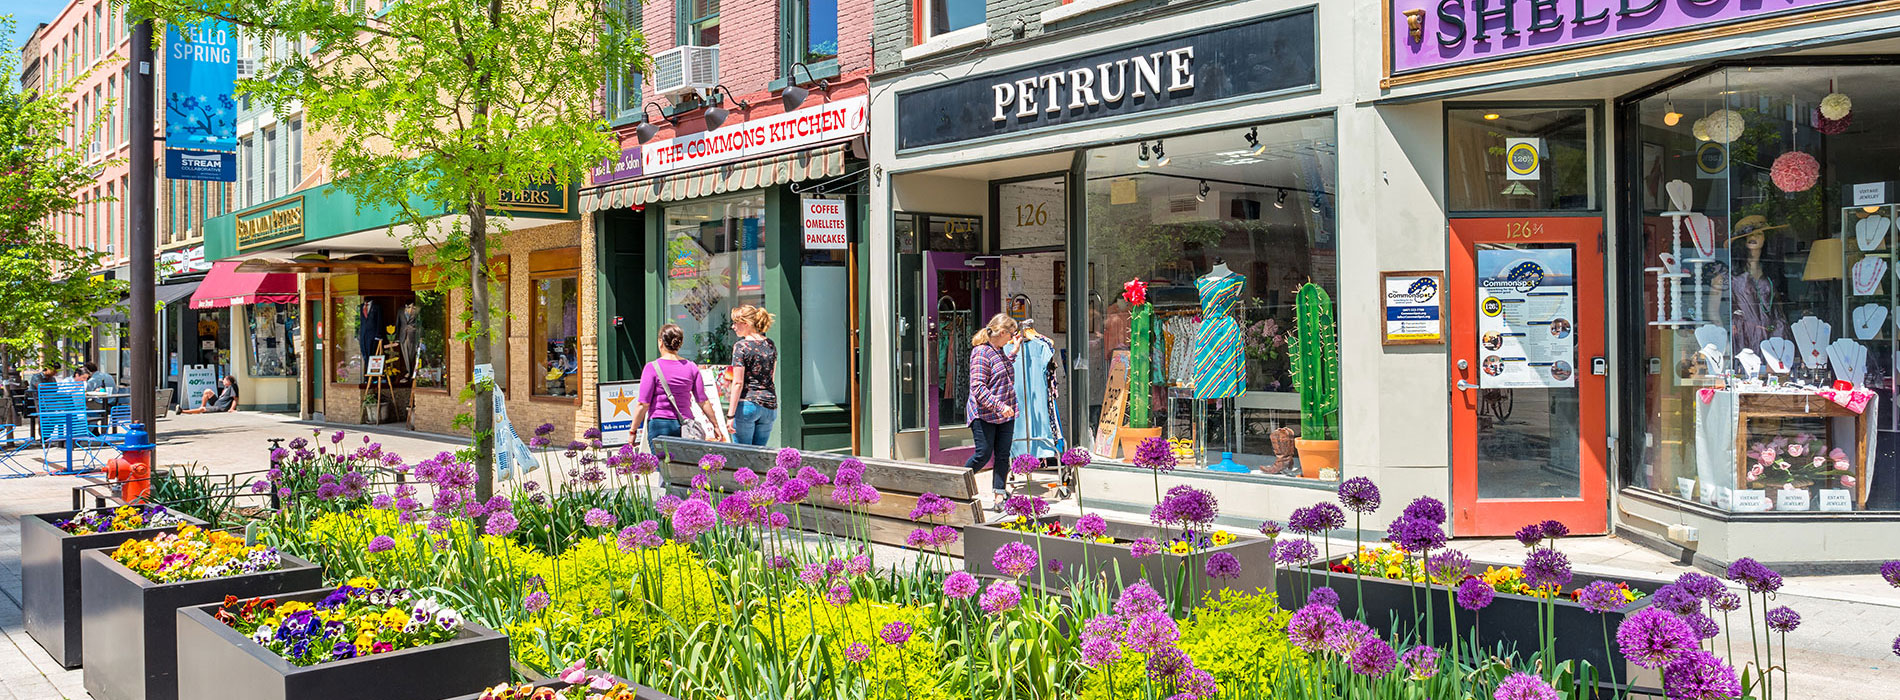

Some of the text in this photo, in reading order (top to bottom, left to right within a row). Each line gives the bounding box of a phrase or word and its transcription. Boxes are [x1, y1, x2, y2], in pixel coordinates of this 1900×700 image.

[173, 43, 231, 64] SPRING
[992, 46, 1195, 122] PETRUNE
[656, 108, 847, 165] THE COMMONS KITCHEN
[181, 159, 222, 168] STREAM
[625, 153, 640, 171] Salon
[810, 204, 839, 214] COFFEE
[1015, 202, 1048, 228] 126
[272, 207, 301, 231] PETERS
[805, 219, 845, 229] OMELLETES
[806, 234, 846, 244] PANCAKES
[670, 267, 697, 278] OPEN
